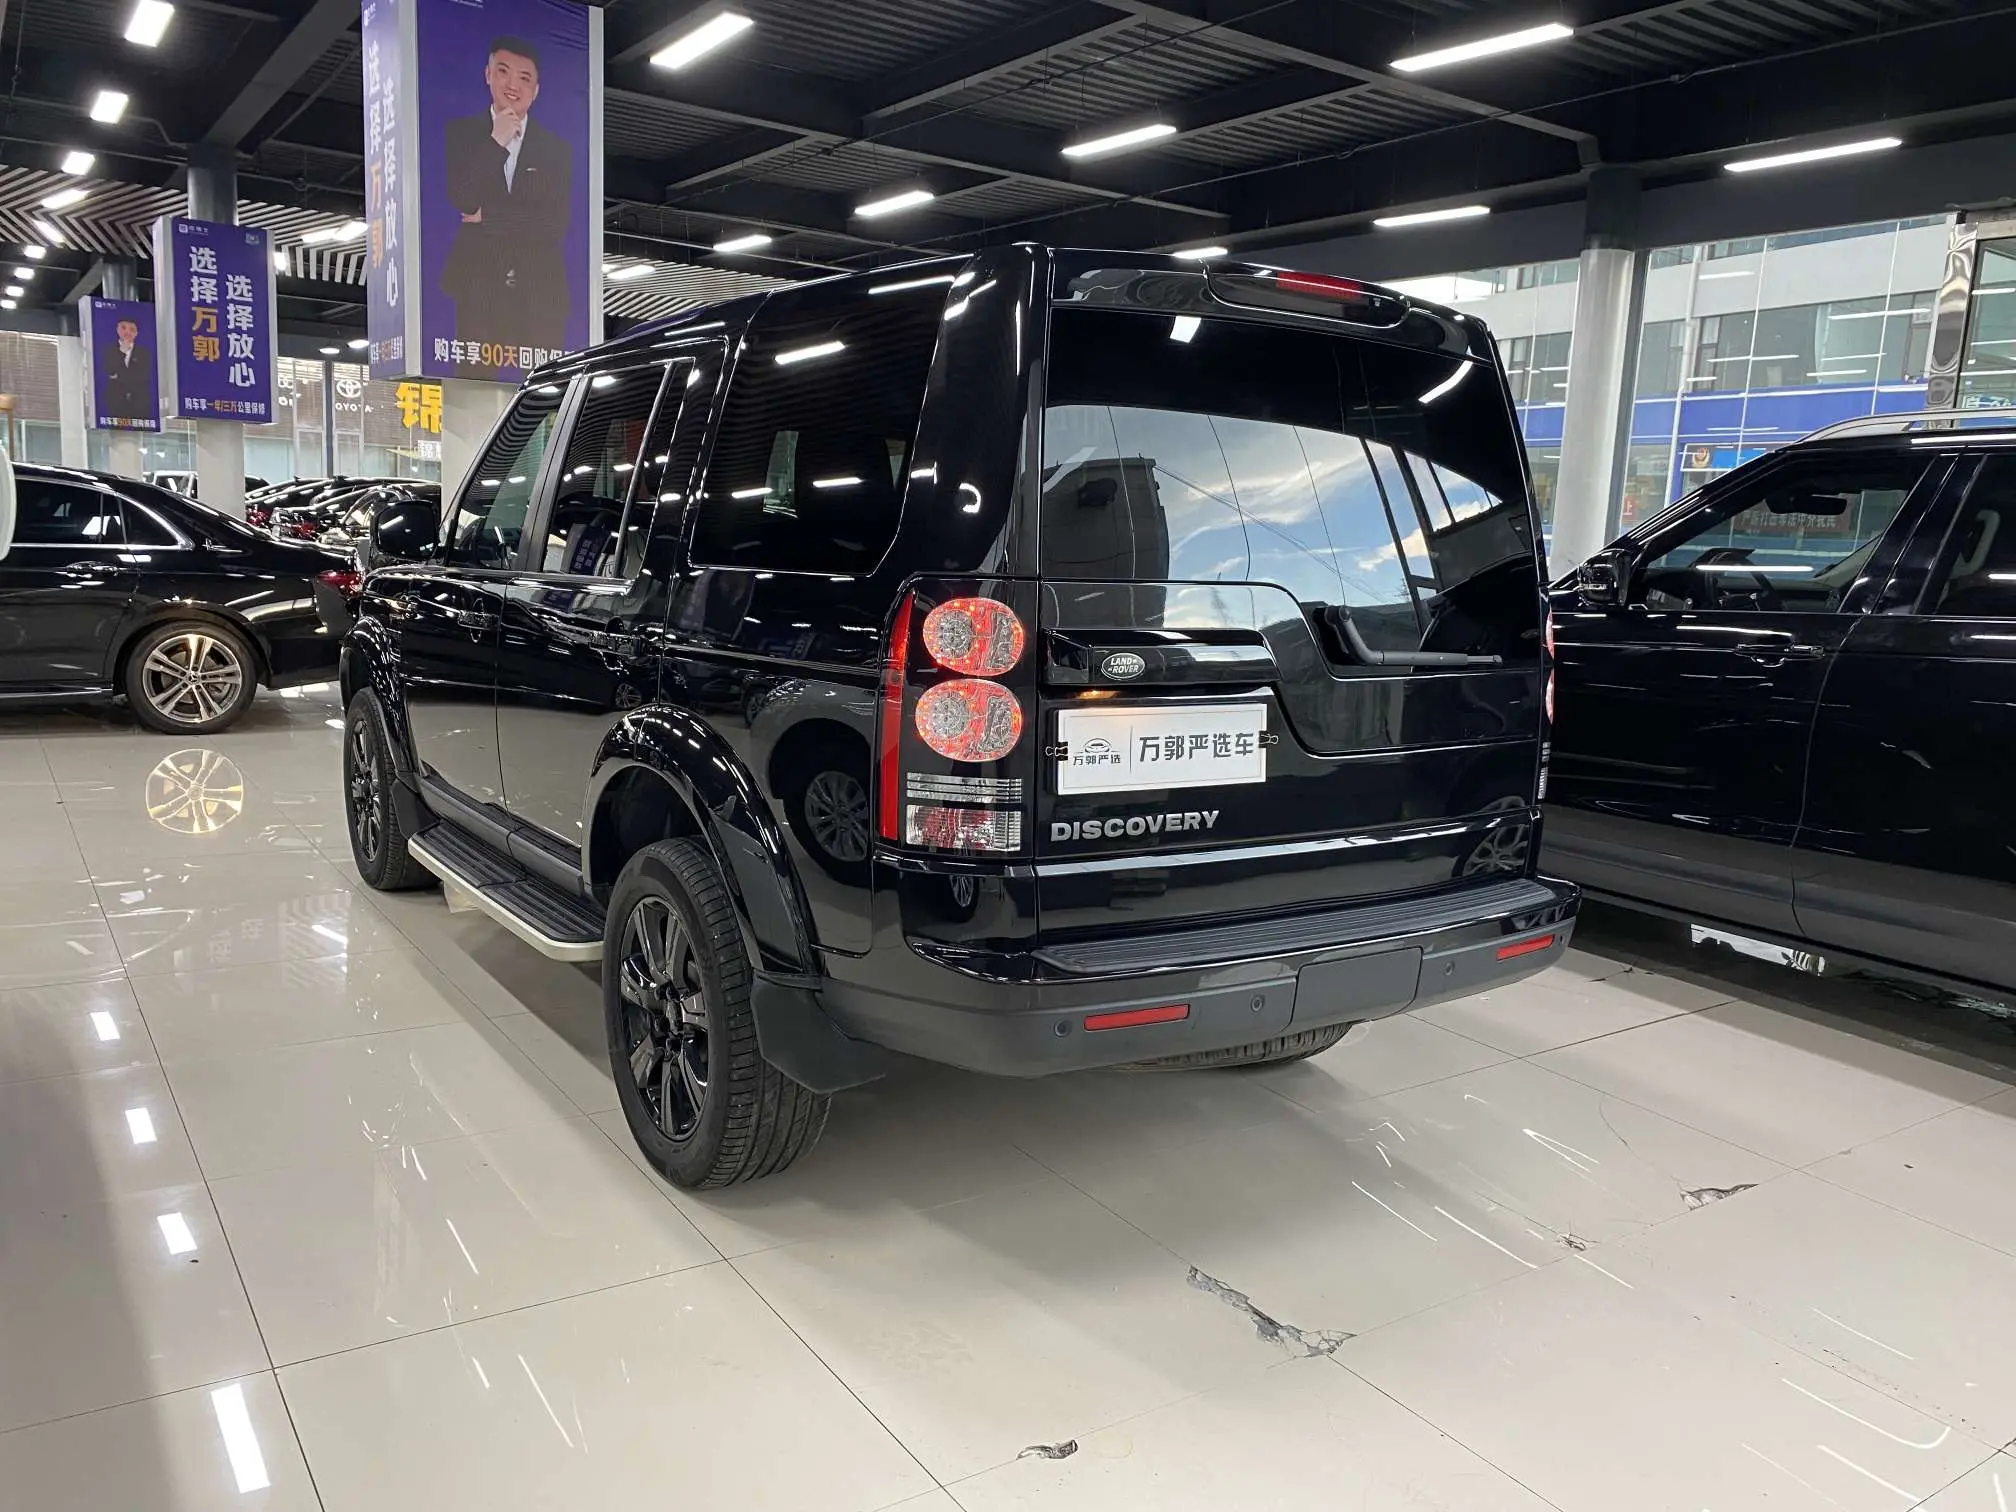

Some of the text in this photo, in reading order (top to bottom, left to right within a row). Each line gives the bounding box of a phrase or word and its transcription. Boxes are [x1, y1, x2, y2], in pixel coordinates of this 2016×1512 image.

[368, 40, 383, 269] 选择万郭
[382, 78, 398, 308] 选择放心
[189, 245, 220, 363] 选择万郭
[225, 273, 255, 388] 选择放心
[1110, 657, 1132, 666] LAND
[1112, 664, 1139, 674] ROVER
[1139, 732, 1254, 762] 万郭严选车
[1050, 810, 1220, 842] DISCOVERY
